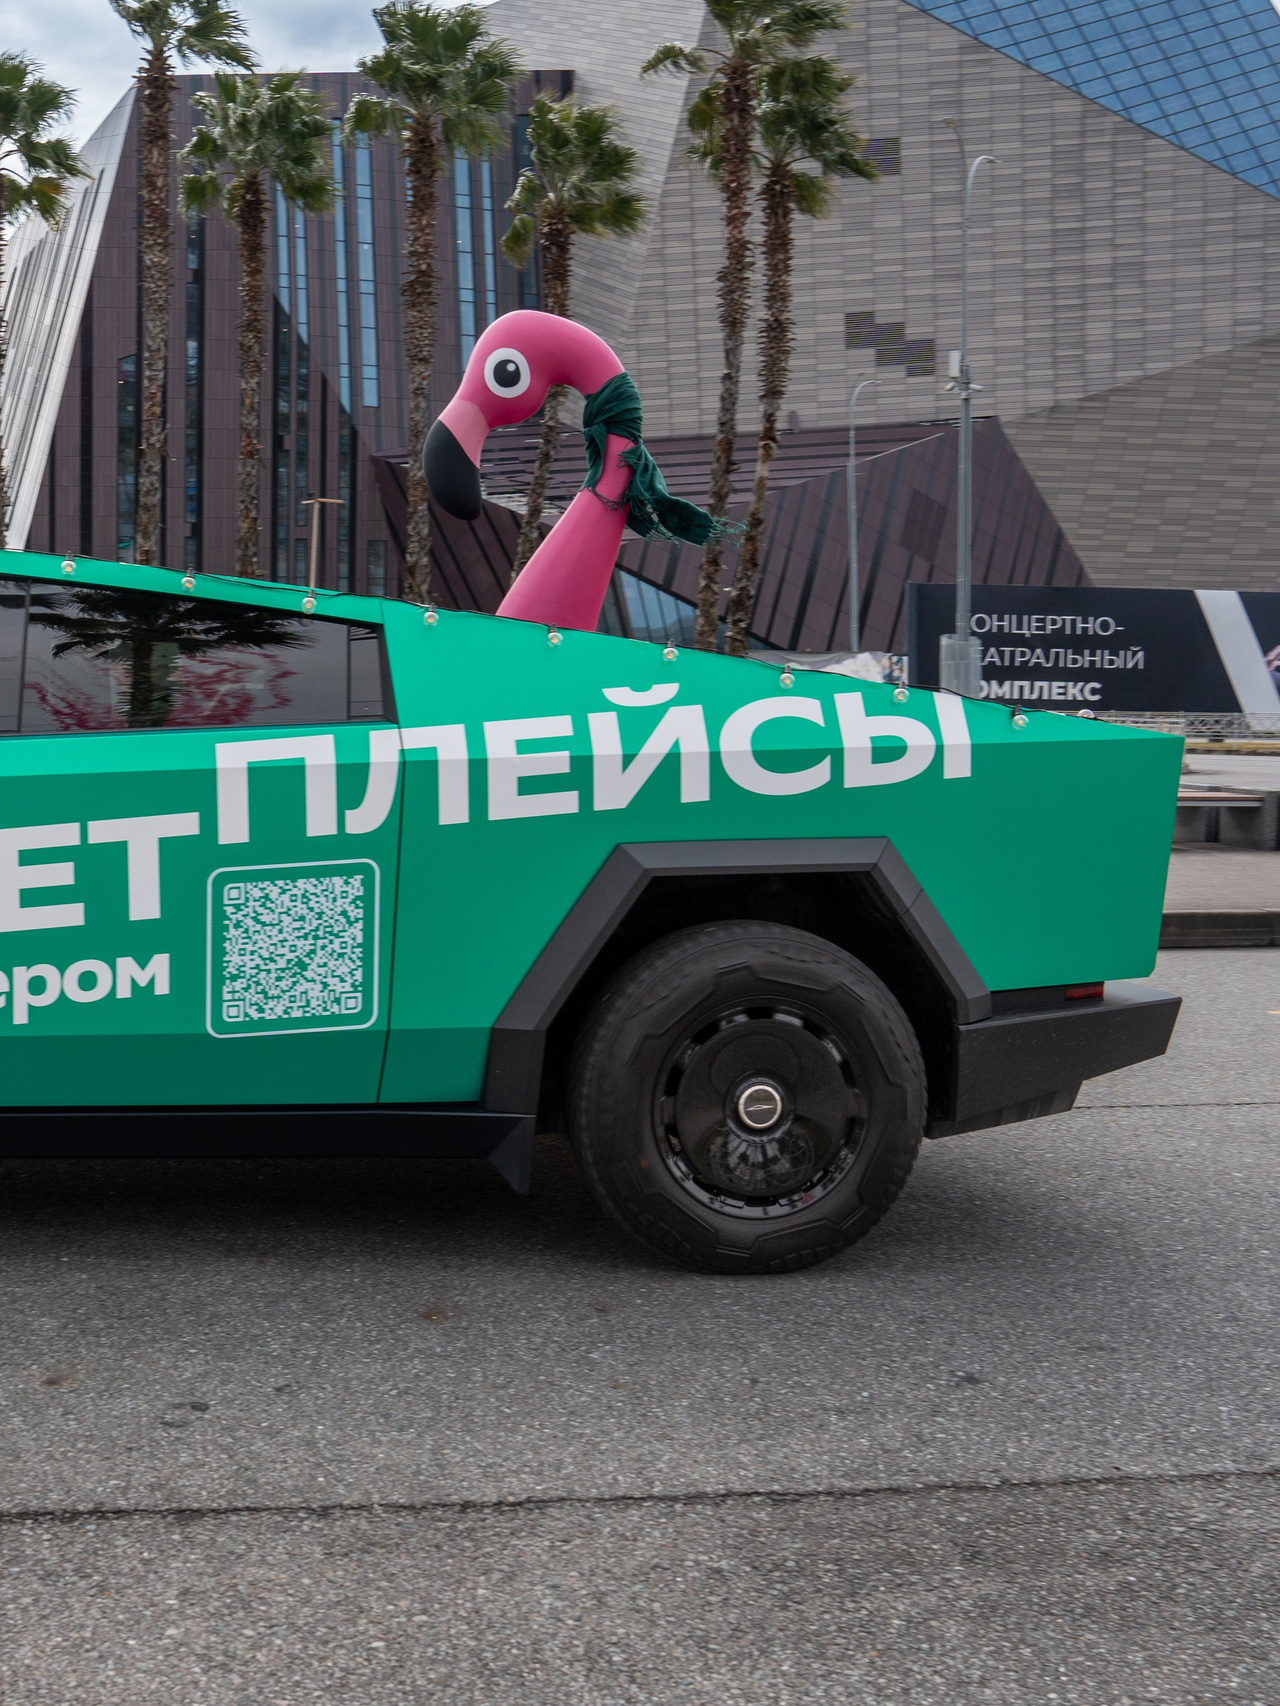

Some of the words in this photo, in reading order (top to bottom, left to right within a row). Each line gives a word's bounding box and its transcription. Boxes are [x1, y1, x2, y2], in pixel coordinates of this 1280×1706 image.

[969, 613, 1125, 637] ОНЦЕРТНО-
[977, 645, 1145, 669] АТРАЛЬНЫЙ
[978, 679, 1103, 701] ОМПЛЕКС
